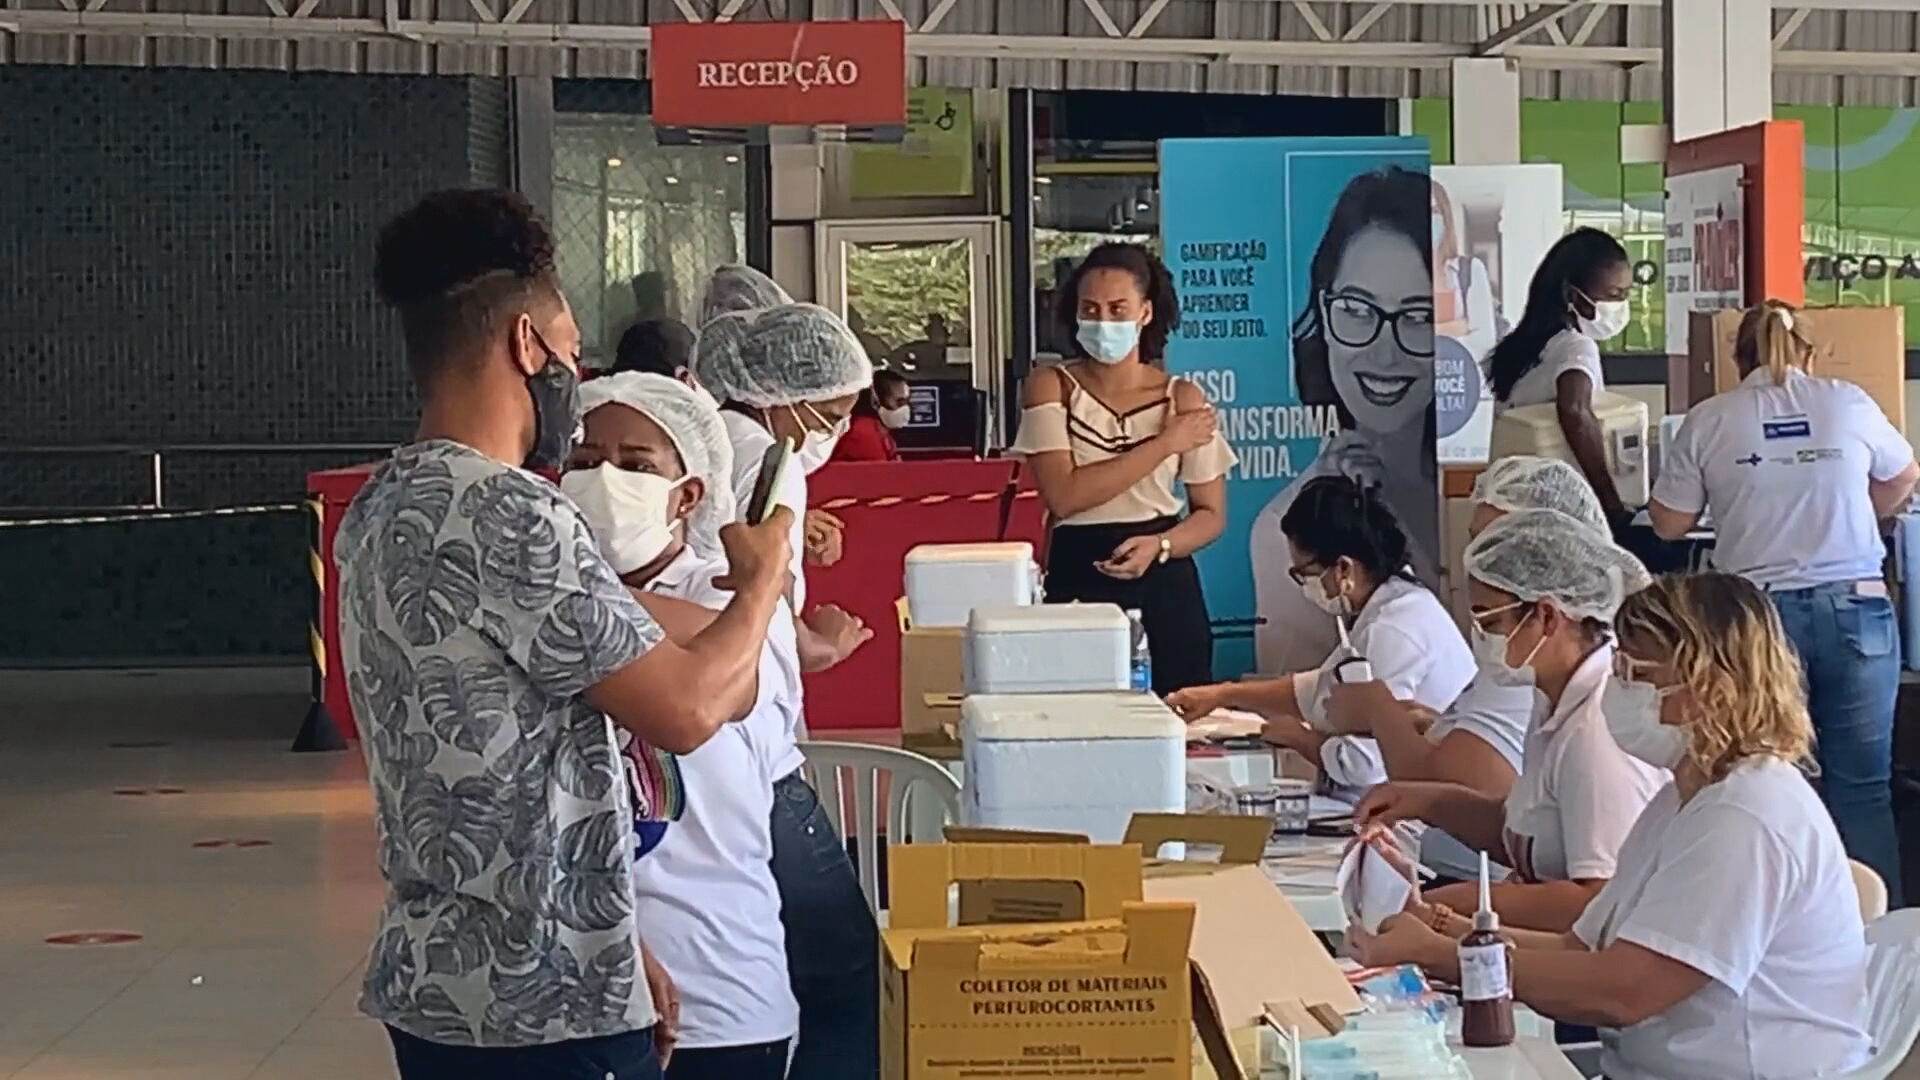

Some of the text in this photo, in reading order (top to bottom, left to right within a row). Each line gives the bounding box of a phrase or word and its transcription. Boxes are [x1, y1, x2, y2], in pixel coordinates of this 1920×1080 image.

[698, 55, 858, 92] RECEPÇÃO
[1181, 239, 1266, 263] GAMIFICAÇÃO
[1182, 265, 1255, 288] PARA VOCÊ
[1183, 293, 1249, 313] APRENDER
[1183, 318, 1268, 338] DO SEU JEITO.
[1216, 404, 1341, 441] ANSFORMA
[1236, 445, 1298, 481] VIDA.
[959, 976, 1168, 994] COLETOR DE MATERIAIS
[973, 998, 1156, 1015] PERFUROCORTANTES
